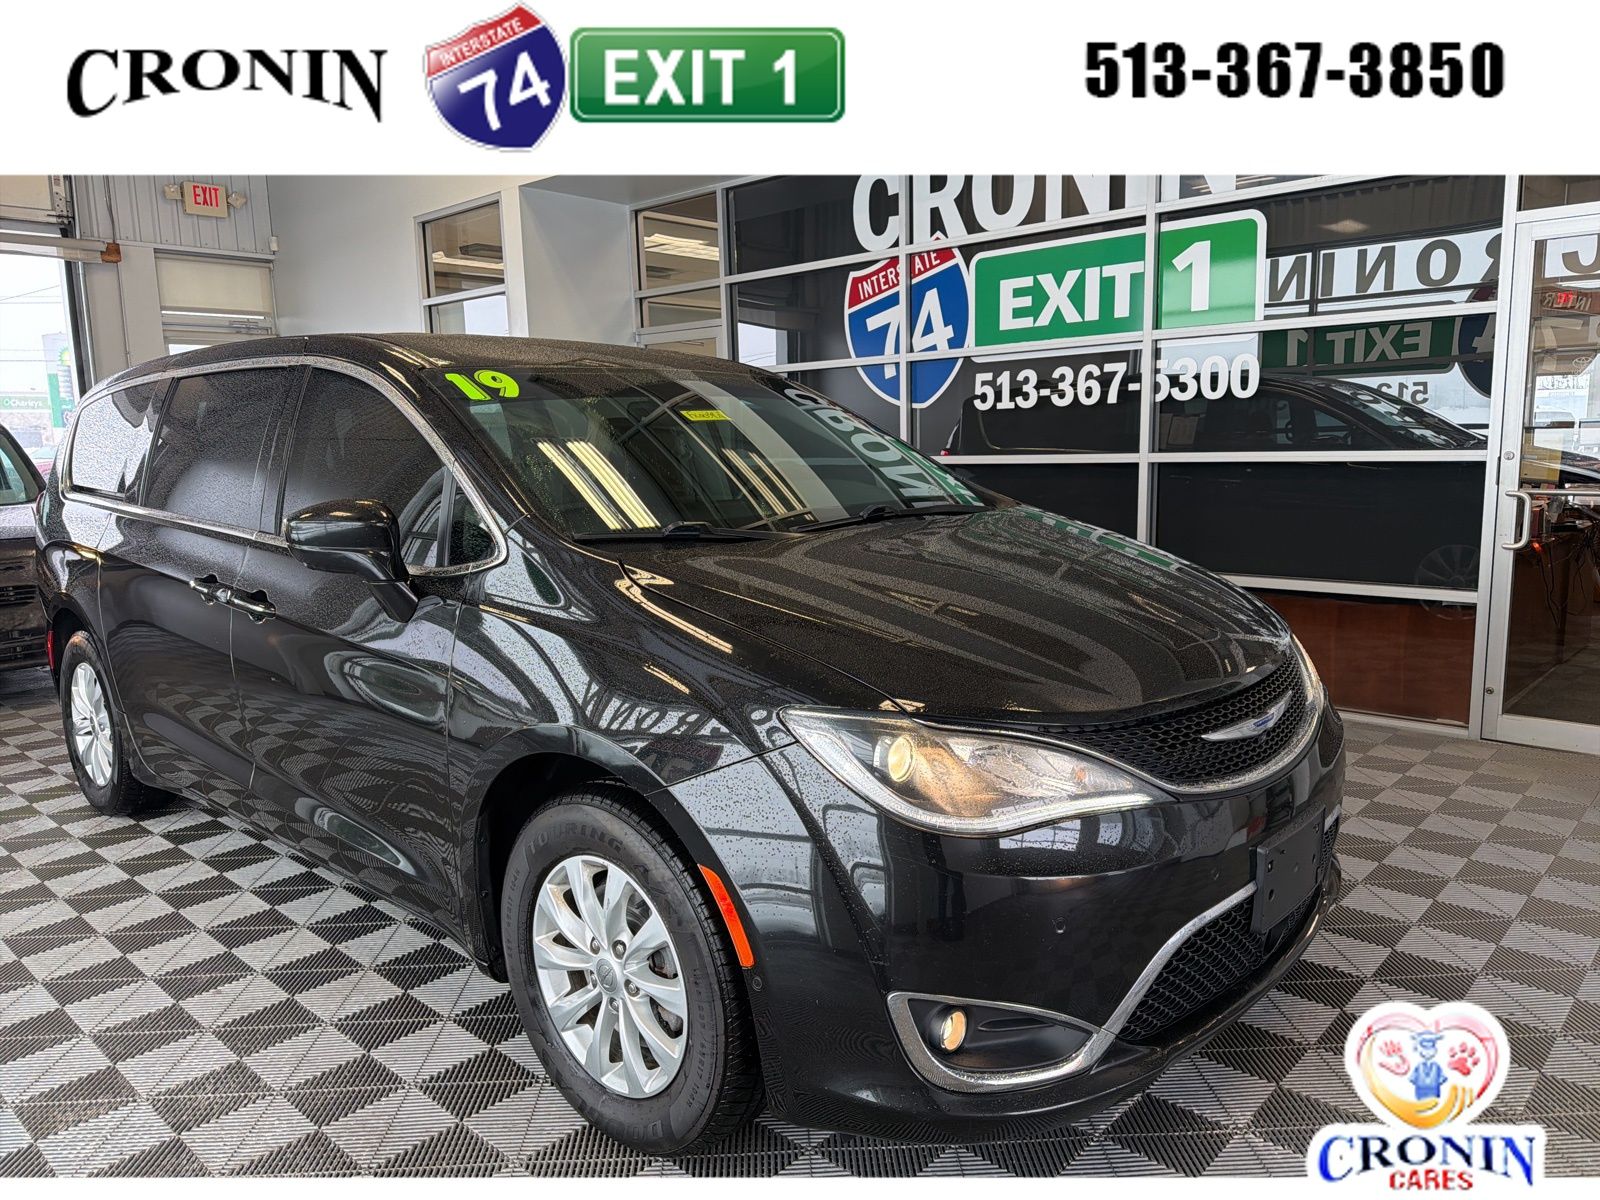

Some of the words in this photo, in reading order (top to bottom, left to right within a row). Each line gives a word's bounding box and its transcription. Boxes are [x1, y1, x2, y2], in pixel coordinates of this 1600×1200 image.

[192, 184, 220, 208] EXIT
[857, 250, 941, 301] INTERATE
[1000, 260, 1144, 331] EXIT
[1172, 240, 1212, 312] 1
[865, 287, 955, 380] 74
[444, 369, 520, 401] 19
[973, 352, 1260, 412] 513-367-5300
